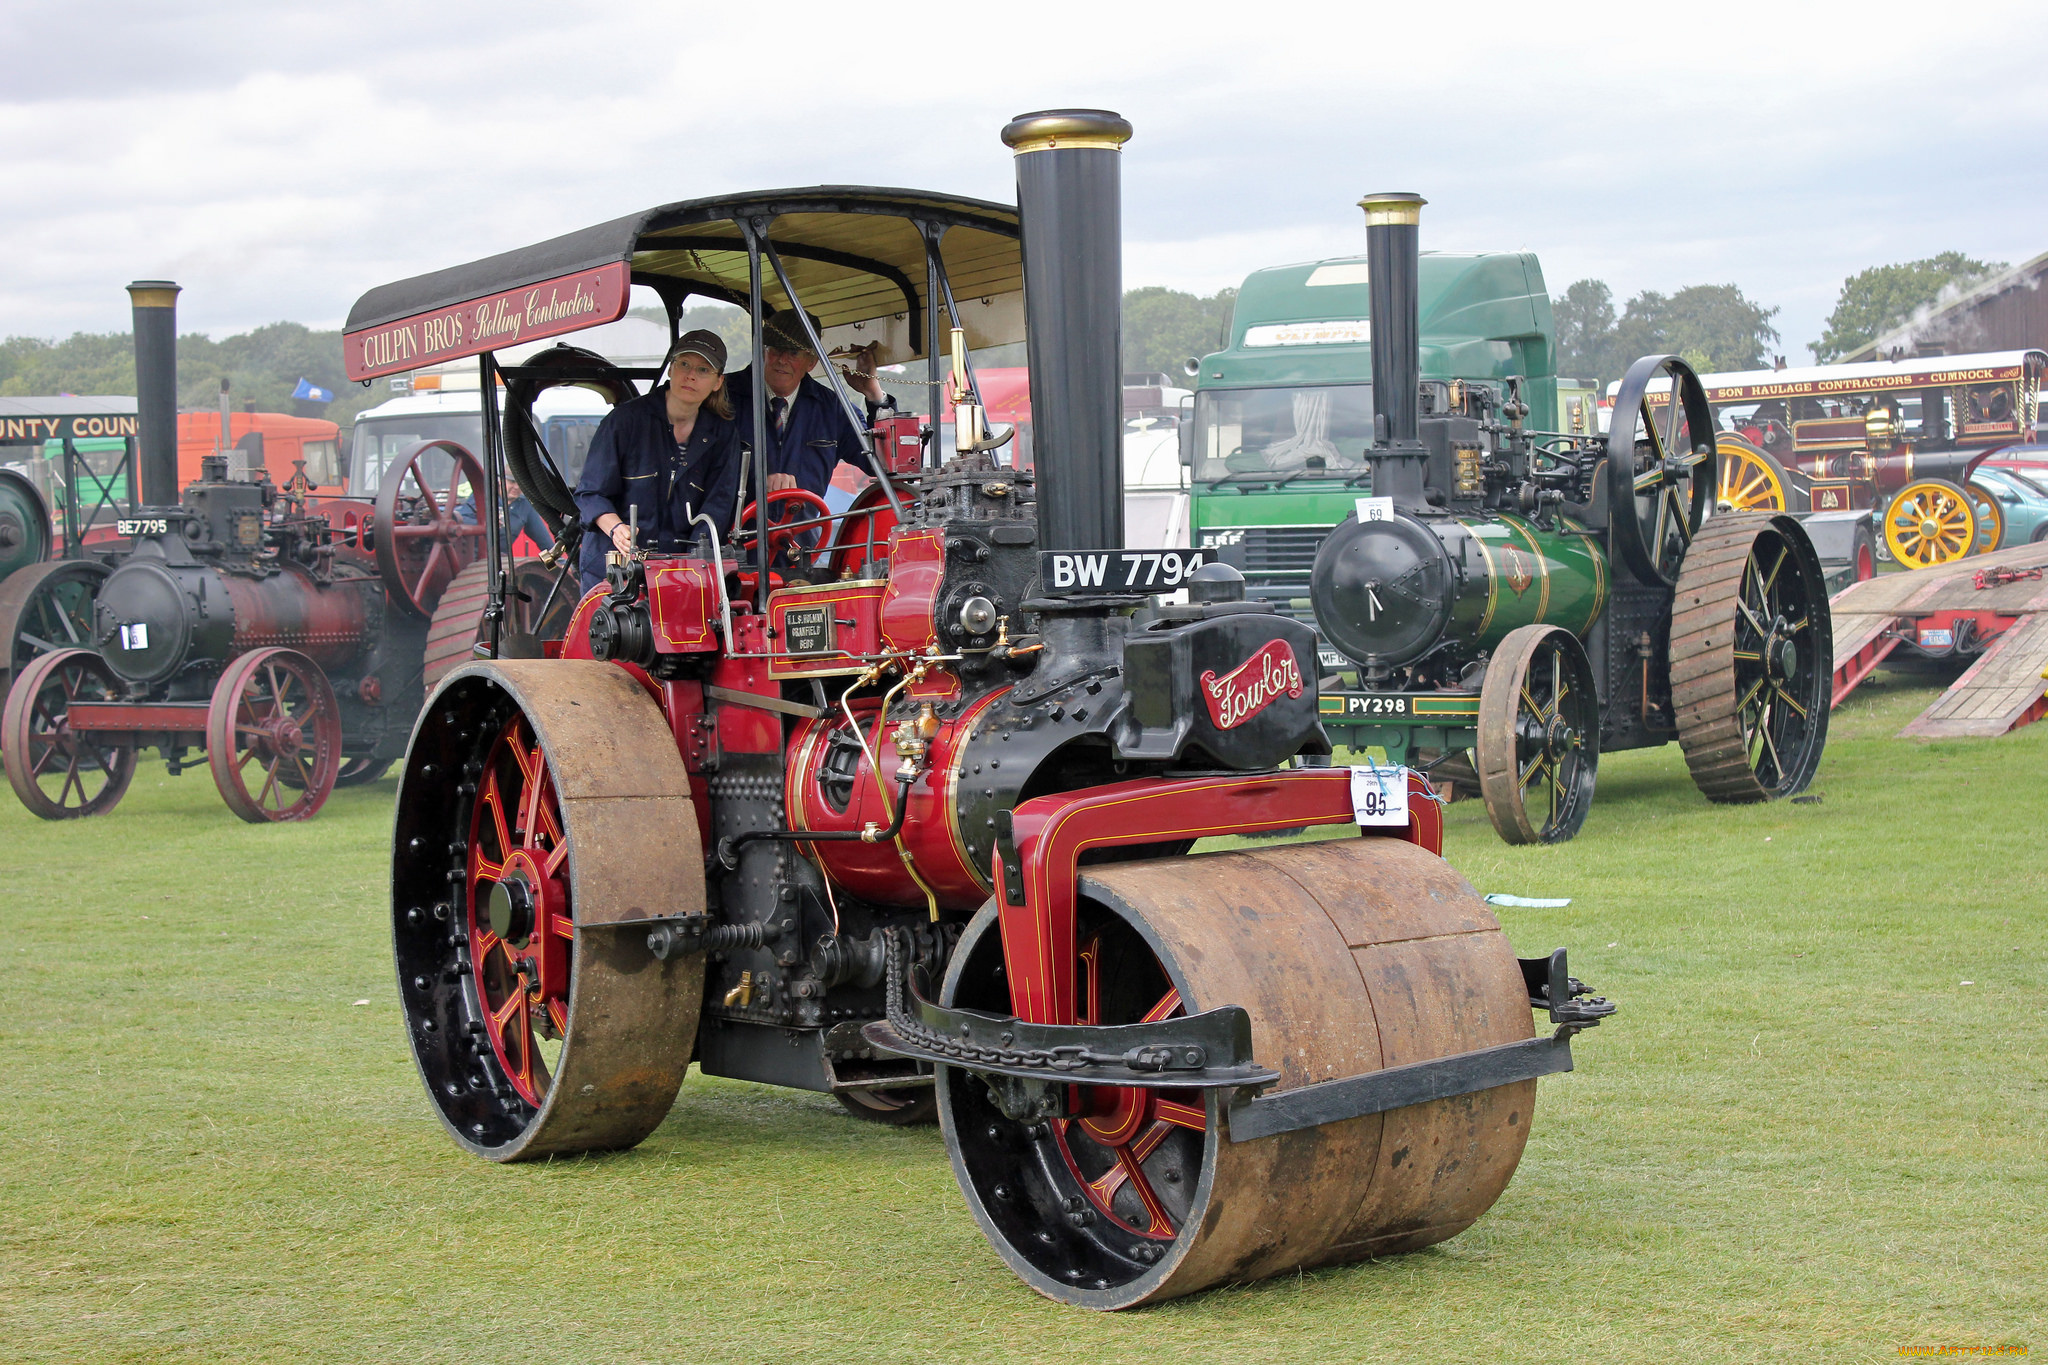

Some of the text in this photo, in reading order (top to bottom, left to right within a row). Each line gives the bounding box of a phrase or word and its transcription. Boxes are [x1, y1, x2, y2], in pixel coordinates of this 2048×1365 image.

[364, 324, 418, 367] CULPIN
[472, 296, 522, 341] Rolling
[525, 283, 595, 327] Contractors
[1718, 387, 1743, 398] SON
[1752, 382, 1812, 395] HAULAGE
[1818, 375, 1912, 391] CONTRACTORS
[1931, 369, 1994, 382] CUMNOCK
[0, 417, 139, 439] NTY COUN
[1369, 508, 1383, 521] 69
[117, 519, 168, 535] BE7795
[1203, 535, 1242, 546] ERF
[1053, 552, 1204, 588] BW 7794
[1213, 653, 1298, 728] Fowler
[1349, 697, 1406, 713] PY298
[1366, 791, 1387, 816] 95
